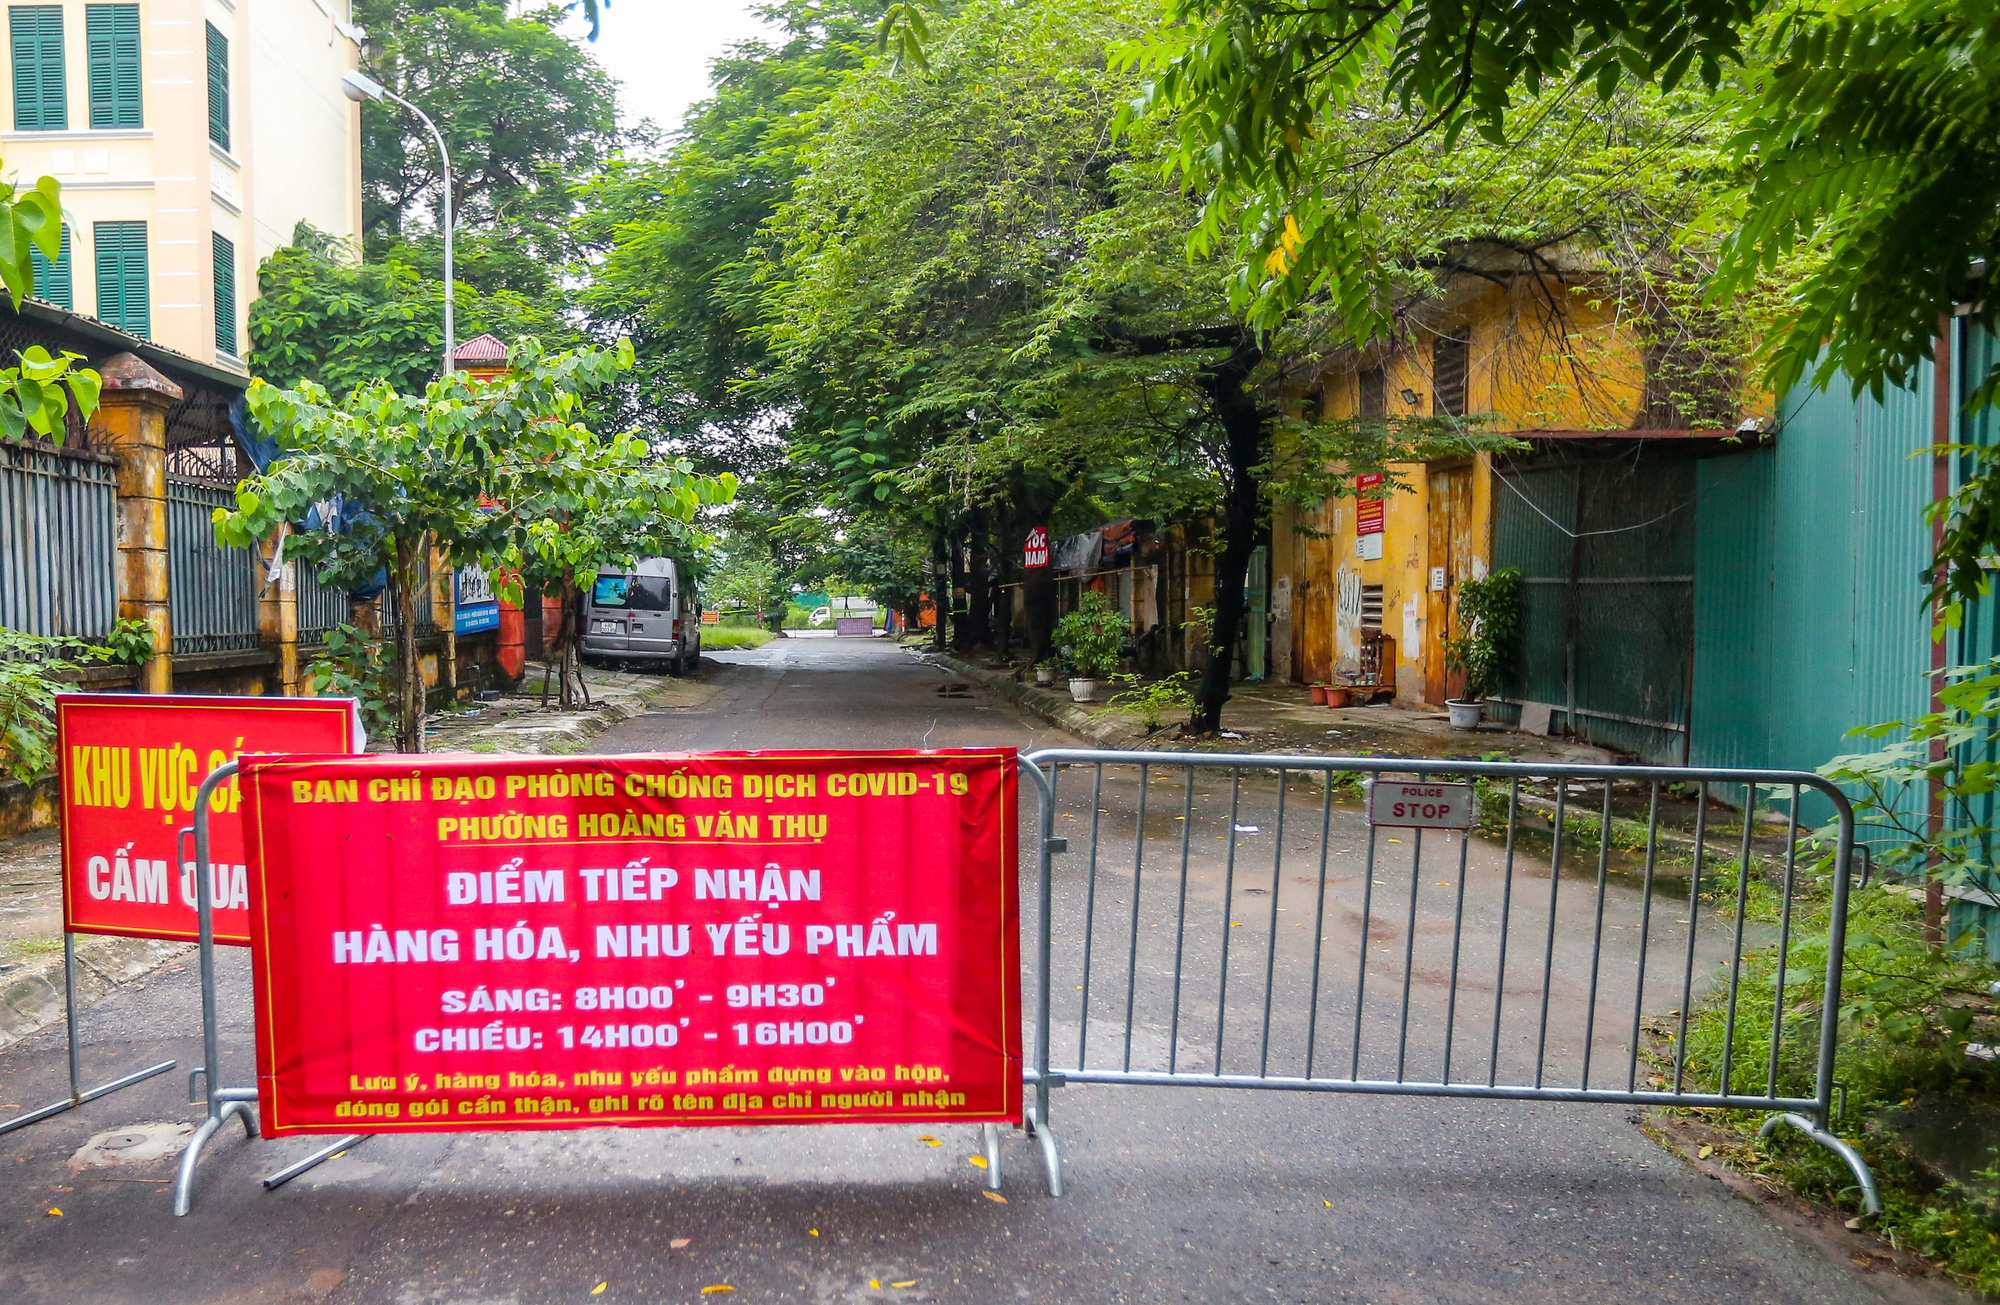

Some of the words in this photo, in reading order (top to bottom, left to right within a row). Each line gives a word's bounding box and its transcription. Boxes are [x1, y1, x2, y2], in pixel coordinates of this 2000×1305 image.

[1025, 551, 1046, 565] NAM
[73, 746, 130, 808] KHU
[139, 742, 198, 825] VỰC
[292, 780, 358, 803] BAN
[369, 770, 421, 802] CHỈ
[431, 776, 495, 805] ĐẠO
[507, 769, 614, 798] PHÒNG
[625, 767, 732, 798] CHỐNG
[743, 775, 816, 803] DỊCH
[827, 773, 967, 796] COVID-19
[1402, 788, 1443, 797] POLICE
[438, 811, 568, 841] PHƯỜNG
[579, 809, 686, 838] HOÀNG
[696, 811, 758, 839] VĂN
[769, 814, 828, 843] THỤ
[1392, 802, 1450, 819] STOP
[88, 842, 168, 904] CẤM
[181, 861, 249, 912] QUA
[447, 857, 564, 904] ĐIỂM
[580, 858, 678, 901] TIẾP
[695, 863, 820, 908] NHẬN
[334, 924, 459, 963] HÀNG
[475, 921, 579, 962] HÓA,
[705, 913, 790, 955] YẾU
[806, 911, 937, 957] PHẨM
[442, 986, 561, 1013] SÁNG:
[415, 1020, 542, 1051] CHIỀU:
[351, 1075, 396, 1090] Lưu
[405, 1074, 427, 1091] ý,
[436, 1073, 500, 1089] hàng
[509, 1071, 565, 1088] hóa,
[574, 1070, 621, 1086] nhu
[631, 1066, 676, 1086] yếu
[840, 1065, 885, 1081] vào
[336, 1101, 399, 1117] đóng
[409, 1099, 448, 1117] gói
[459, 1095, 505, 1114] cẩn
[515, 1096, 580, 1116] thận,
[589, 1096, 628, 1113] ghi
[639, 1095, 663, 1110] rõ
[673, 1094, 713, 1109] tên
[723, 1094, 762, 1112] địa
[822, 1091, 892, 1108] người
[903, 1090, 965, 1108] nhận
